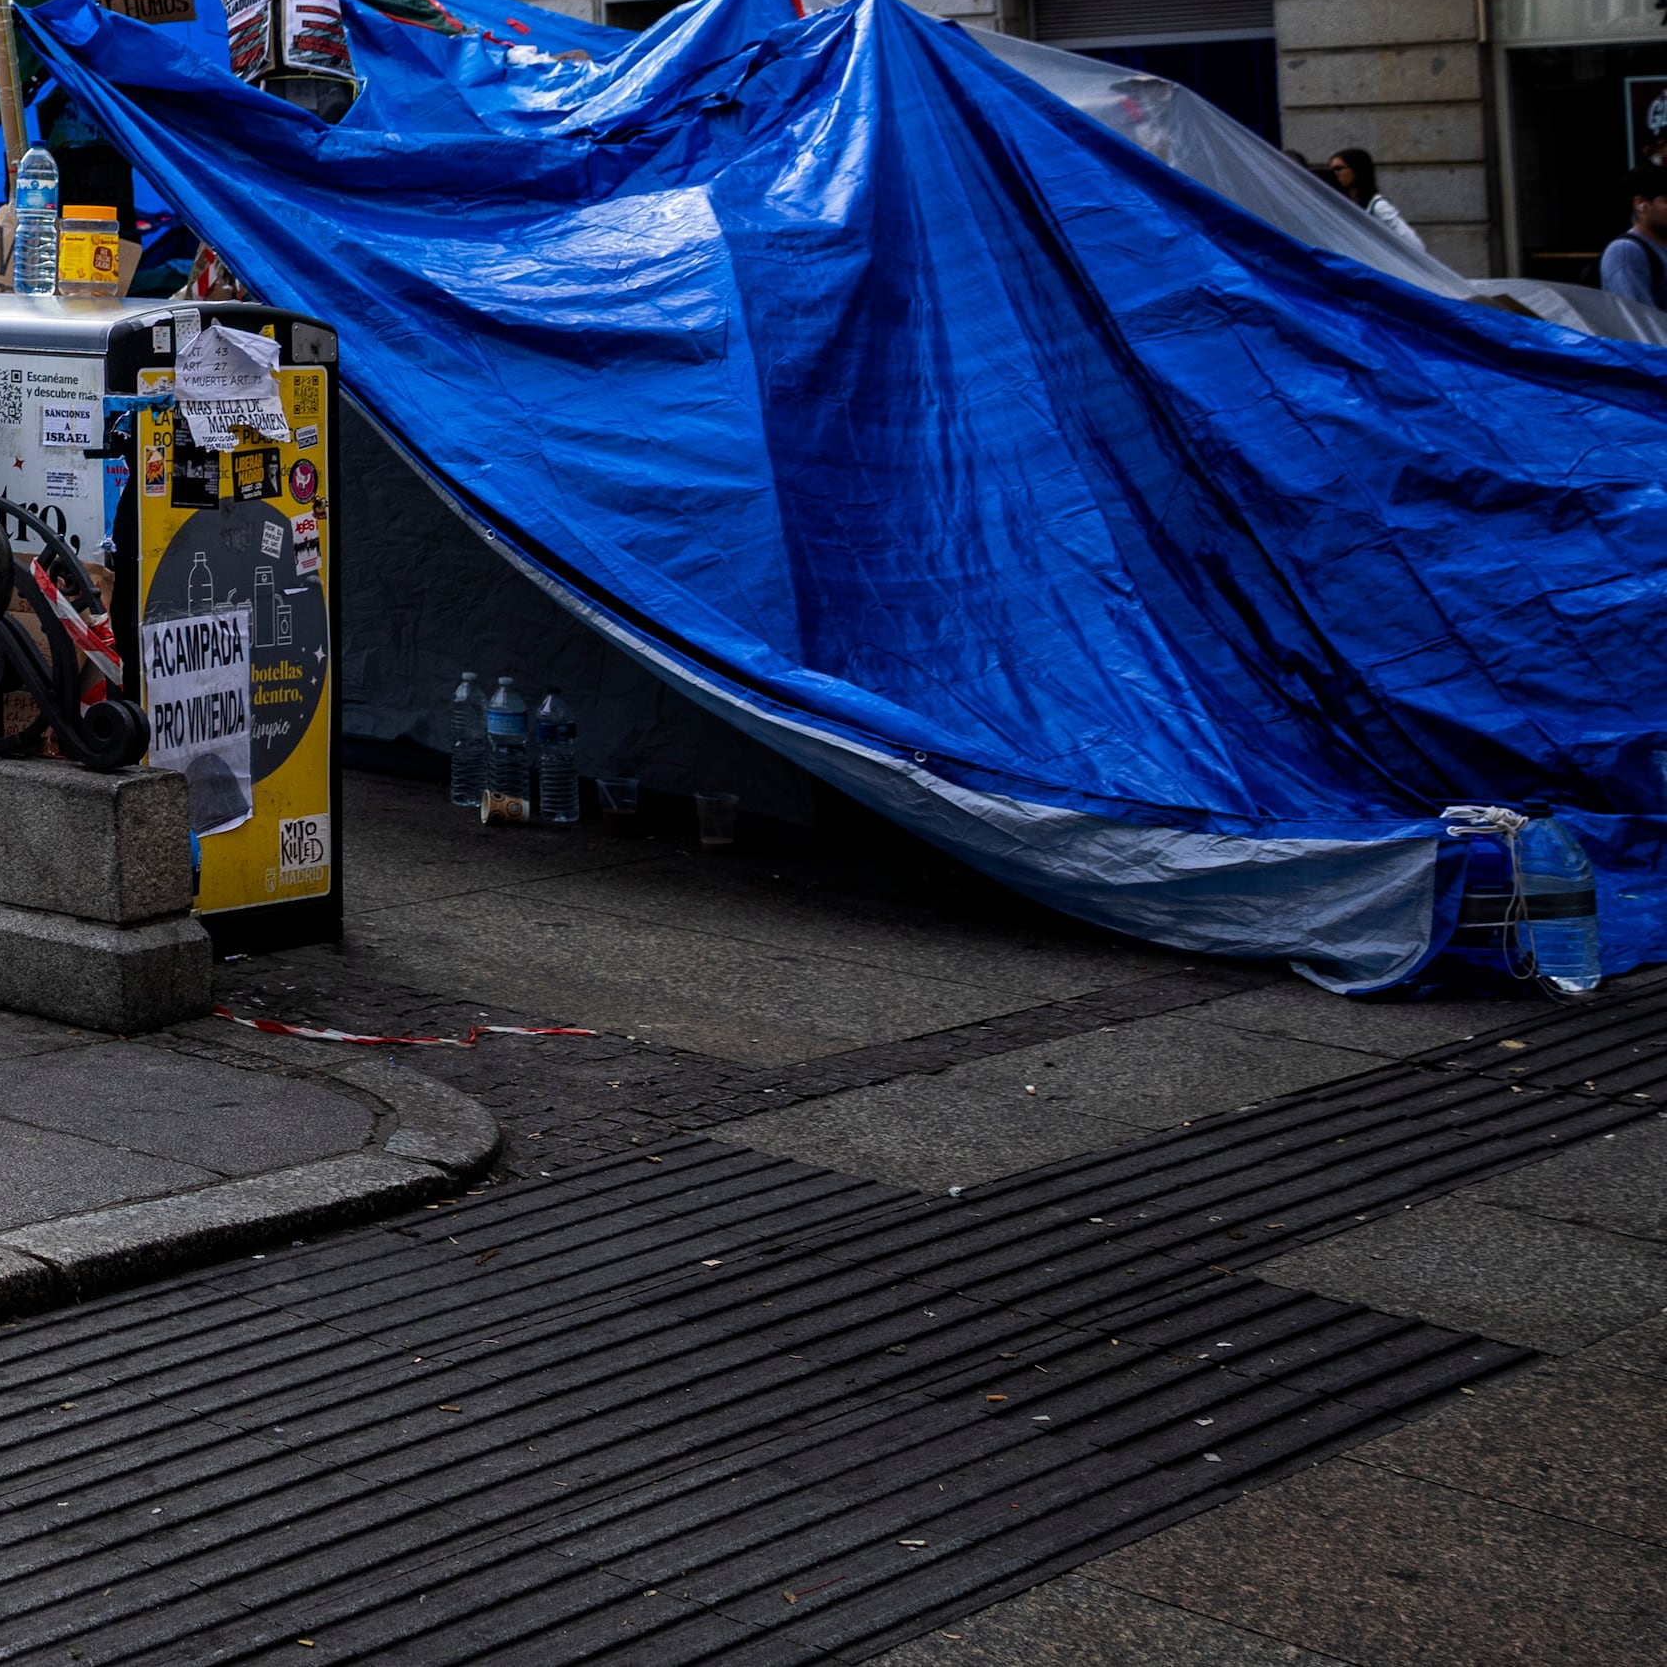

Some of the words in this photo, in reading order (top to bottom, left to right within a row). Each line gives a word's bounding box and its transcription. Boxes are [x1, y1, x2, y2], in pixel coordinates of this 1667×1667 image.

[215, 347, 228, 356] 43
[214, 362, 227, 371] 27
[27, 371, 79, 385] Escanéame
[183, 376, 190, 386] Y
[191, 377, 228, 387] MUERTE
[26, 388, 33, 399] y
[34, 387, 77, 400] descubre
[78, 389, 100, 401] más.
[44, 409, 90, 419] SANCIONES
[64, 423, 71, 431] A
[45, 432, 90, 444] ISRAEL
[234, 453, 263, 472] LIBERAR
[152, 617, 245, 679] ACAMPADA
[251, 660, 303, 683] botellas
[253, 686, 304, 706] dentro,
[155, 701, 185, 751] PRO
[187, 688, 245, 744] VIVIENDA
[284, 820, 317, 839] VITO
[280, 866, 324, 887] MADRID
